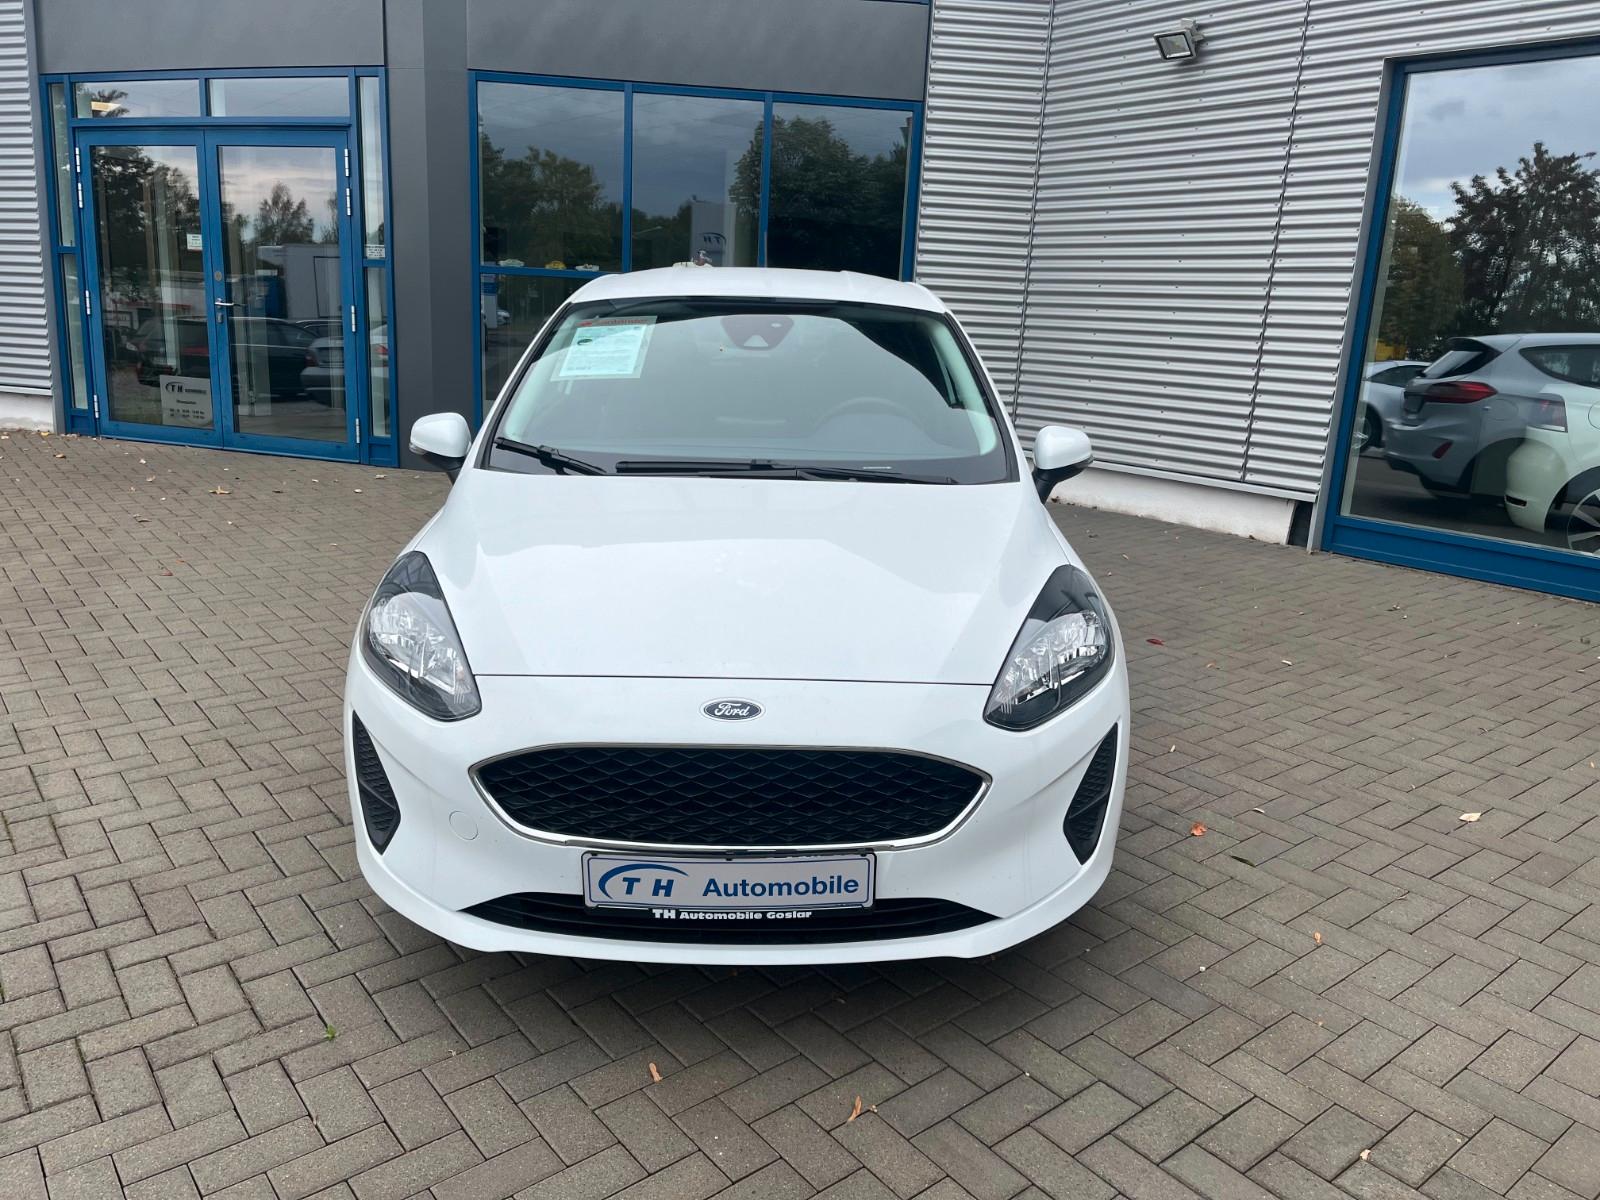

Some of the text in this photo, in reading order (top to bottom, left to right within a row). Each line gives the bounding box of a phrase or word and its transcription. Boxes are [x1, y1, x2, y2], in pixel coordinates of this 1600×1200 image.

[714, 702, 751, 717] Ford
[702, 875, 859, 898] Automobile
[652, 908, 813, 920] TH Automobile Goslar
